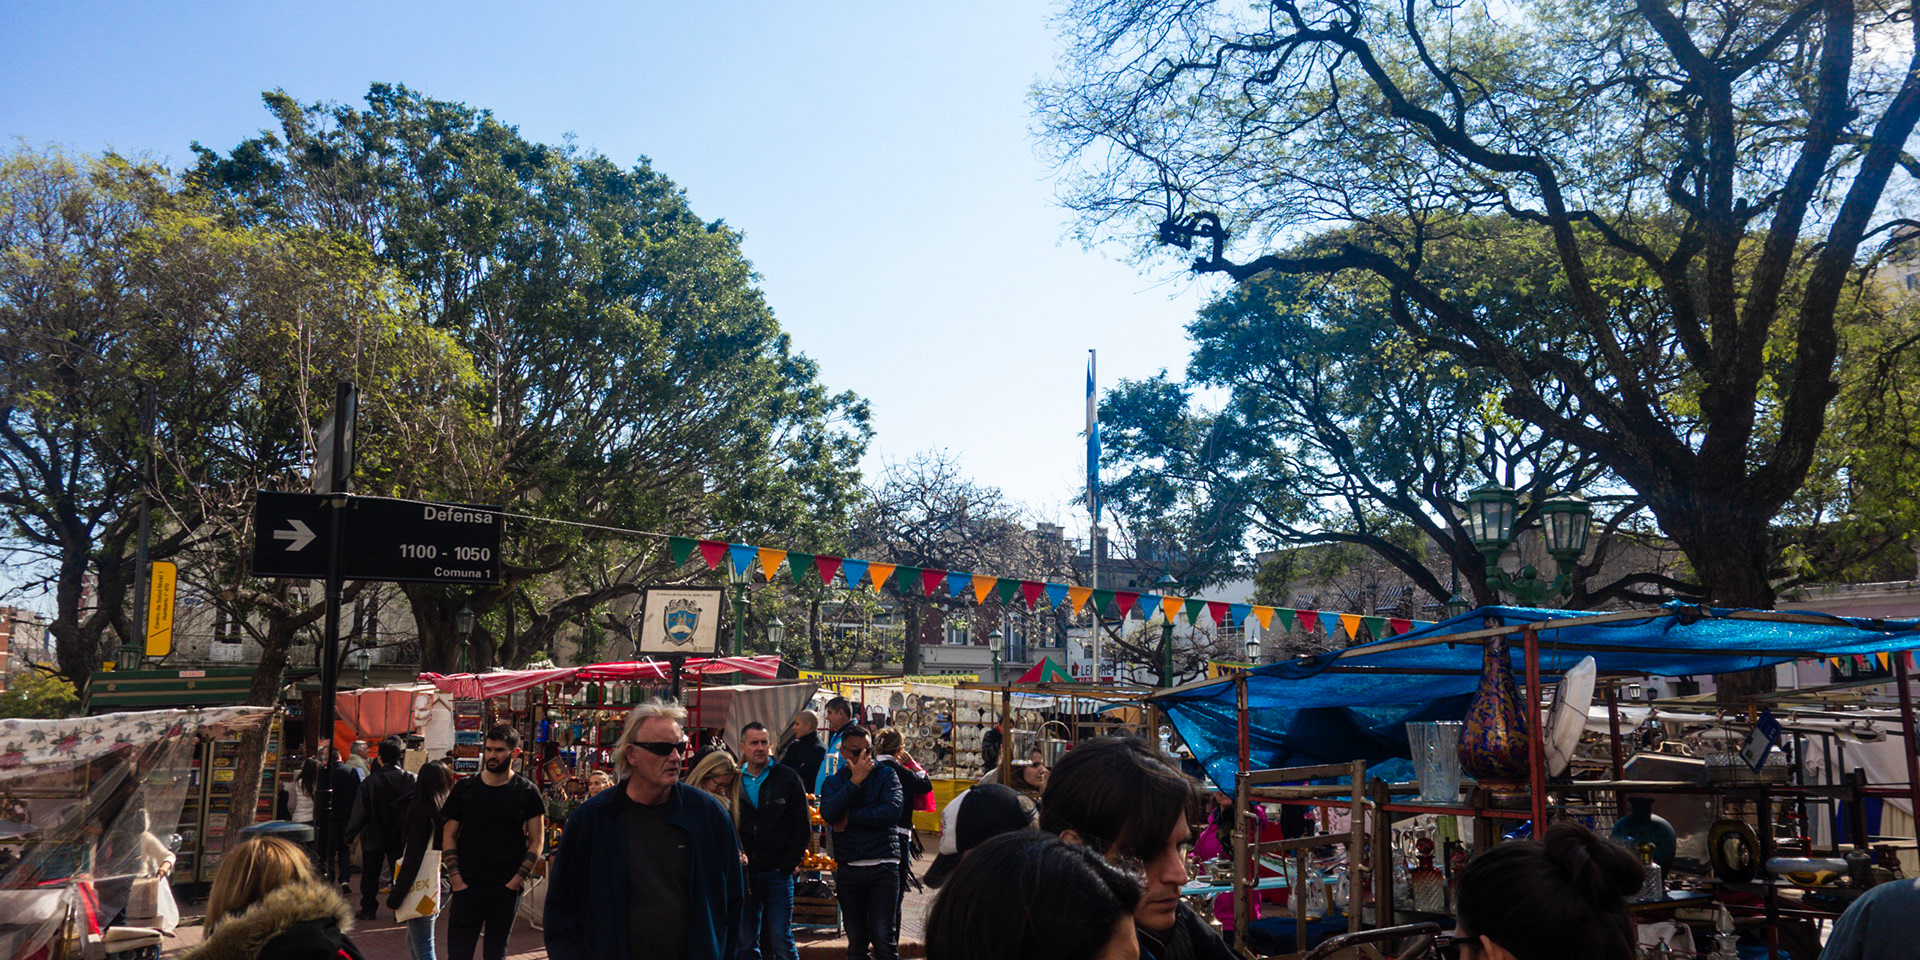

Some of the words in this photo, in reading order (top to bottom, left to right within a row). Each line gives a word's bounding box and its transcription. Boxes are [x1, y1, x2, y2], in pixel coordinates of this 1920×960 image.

[424, 506, 493, 524] Defensa
[400, 544, 437, 559] 1100
[454, 546, 491, 561] 1050
[434, 566, 482, 578] Comuna
[485, 569, 491, 578] 1
